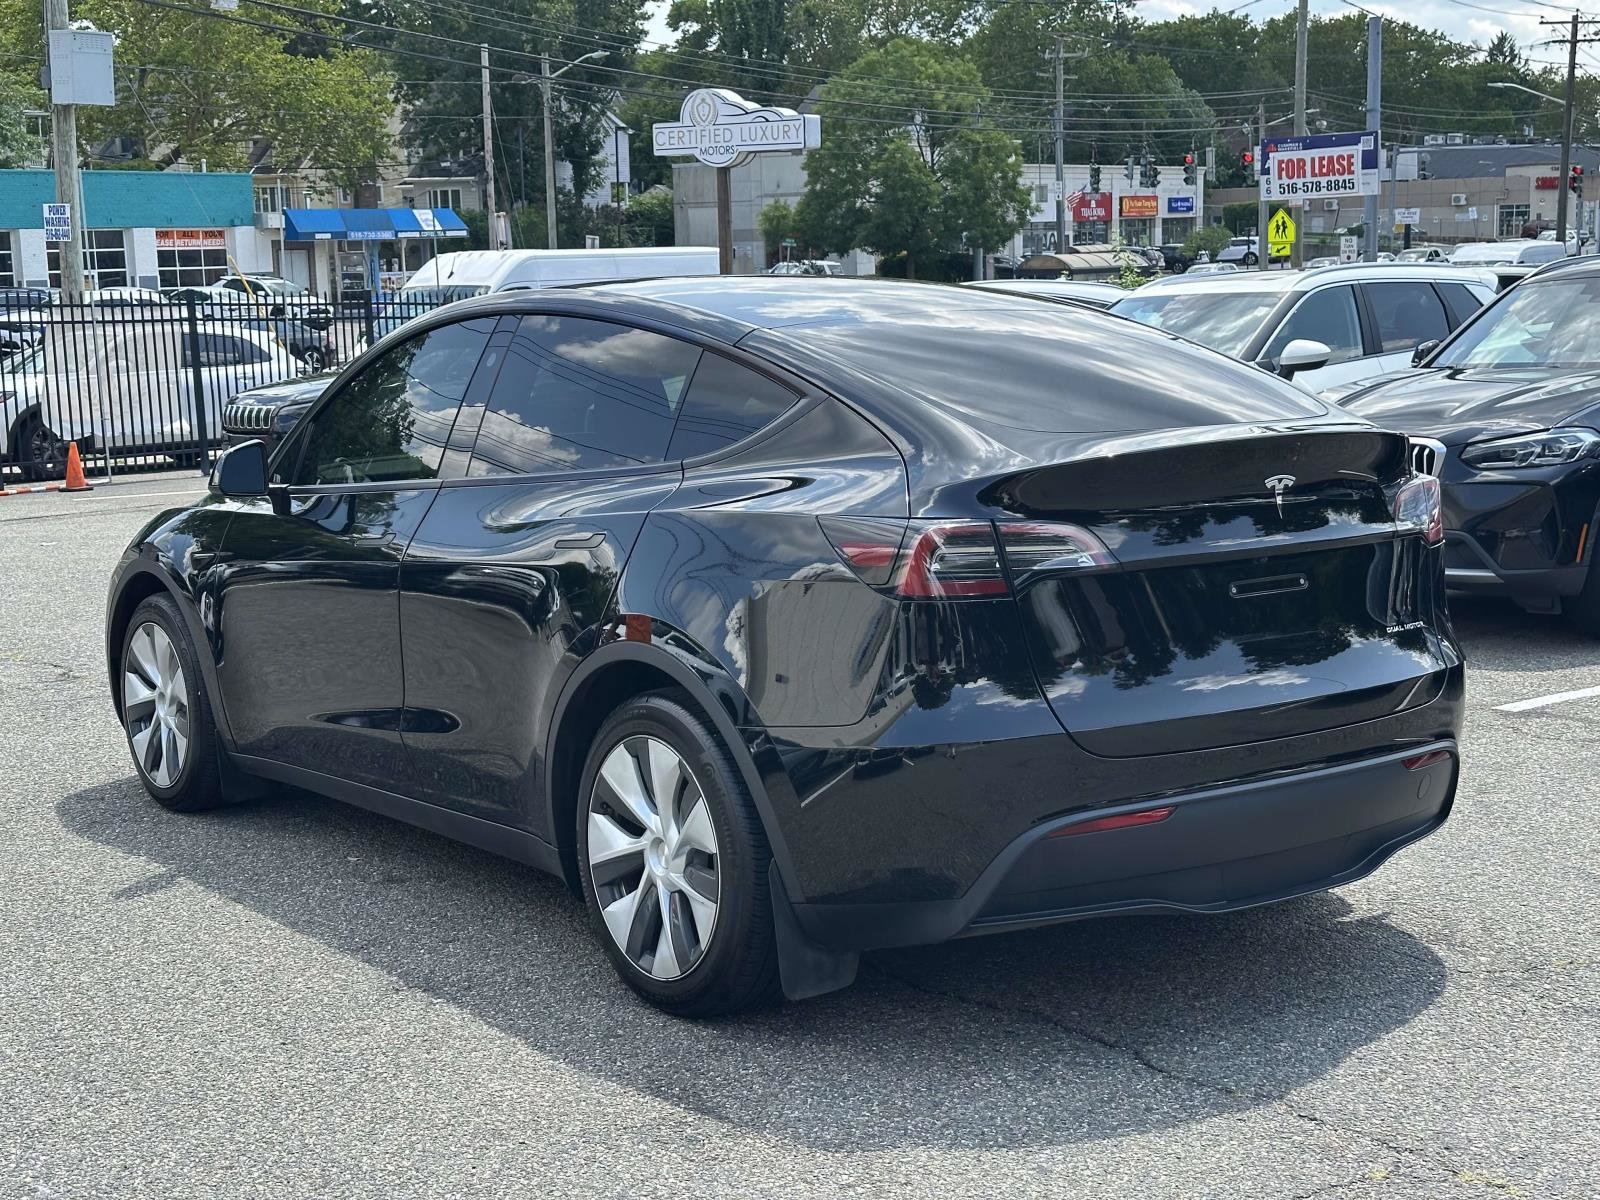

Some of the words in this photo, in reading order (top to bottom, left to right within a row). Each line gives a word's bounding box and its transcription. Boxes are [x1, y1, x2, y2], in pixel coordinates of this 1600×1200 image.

[655, 127, 733, 147] CERTIFIED
[740, 122, 802, 143] LUXURY
[699, 145, 735, 156] MOTORS
[1277, 158, 1307, 180] FOR
[1310, 154, 1355, 178] LEASE
[1279, 178, 1355, 195] 516-578-8845
[48, 205, 67, 216] POWER
[45, 216, 70, 228] WASHING
[155, 230, 169, 238] FOR
[182, 230, 194, 238] ALL
[204, 230, 223, 238] YOUR
[156, 238, 174, 247] EASE
[176, 238, 202, 247] RETURN
[203, 238, 225, 246] NEEDS
[1386, 625, 1404, 633] DUAL
[1404, 620, 1423, 629] MOTOR
